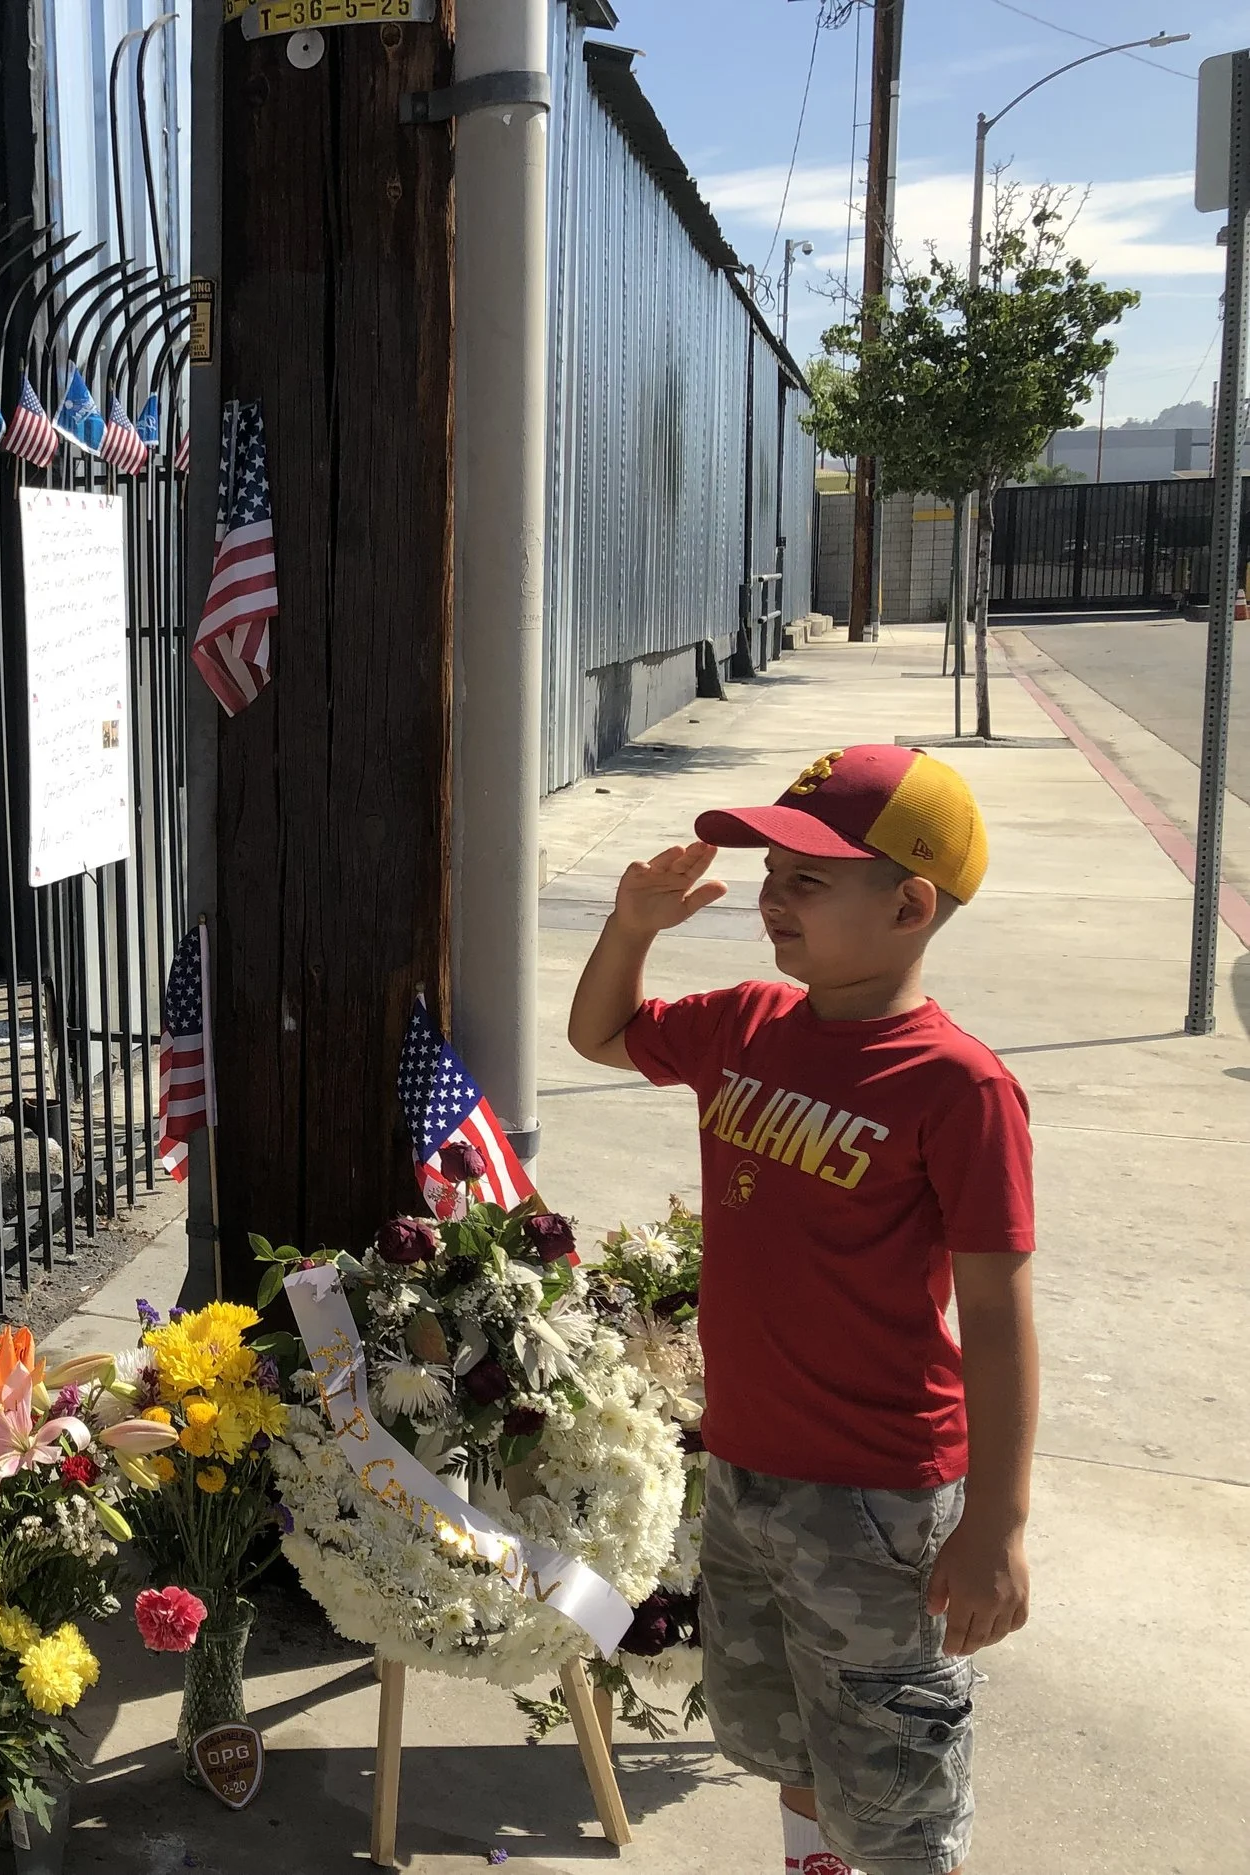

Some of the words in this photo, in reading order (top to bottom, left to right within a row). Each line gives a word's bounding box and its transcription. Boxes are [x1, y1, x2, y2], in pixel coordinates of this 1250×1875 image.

[260, 0, 411, 31] T-36-5-25
[700, 1067, 891, 1191] OJANS
[207, 1744, 250, 1765] OPG
[222, 1780, 248, 1795] 2-20
